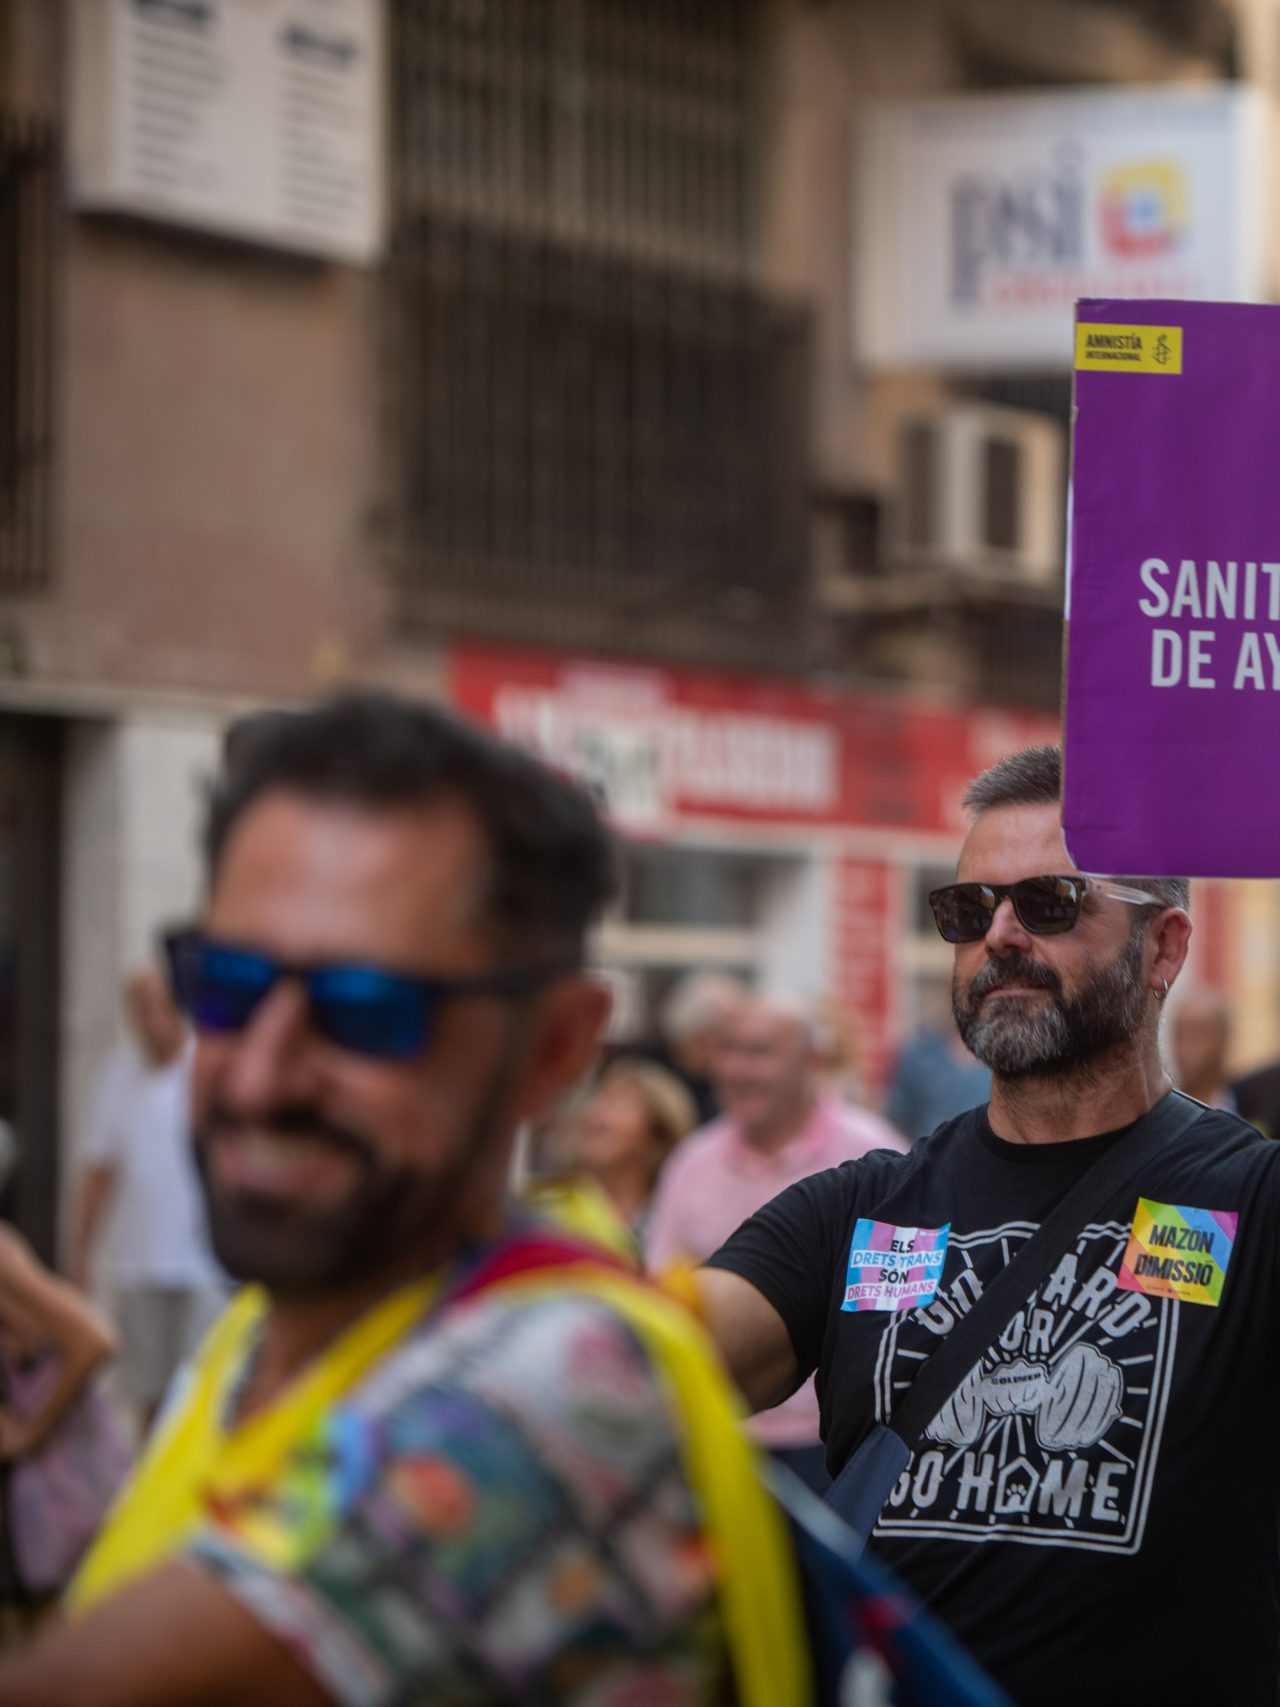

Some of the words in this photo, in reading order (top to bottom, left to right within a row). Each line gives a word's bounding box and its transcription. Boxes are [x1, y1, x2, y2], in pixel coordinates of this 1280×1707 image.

[1086, 332, 1142, 350] AMNISTÍA
[1152, 628, 1216, 689] DE
[890, 1240, 915, 1253] ELS
[853, 1252, 896, 1267] DRETS
[899, 1251, 942, 1268] TRANS
[879, 1268, 909, 1284] SÓN
[847, 1284, 880, 1300] DRETS
[884, 1281, 934, 1298] HUMANS
[1040, 1253, 1151, 1338] ARD
